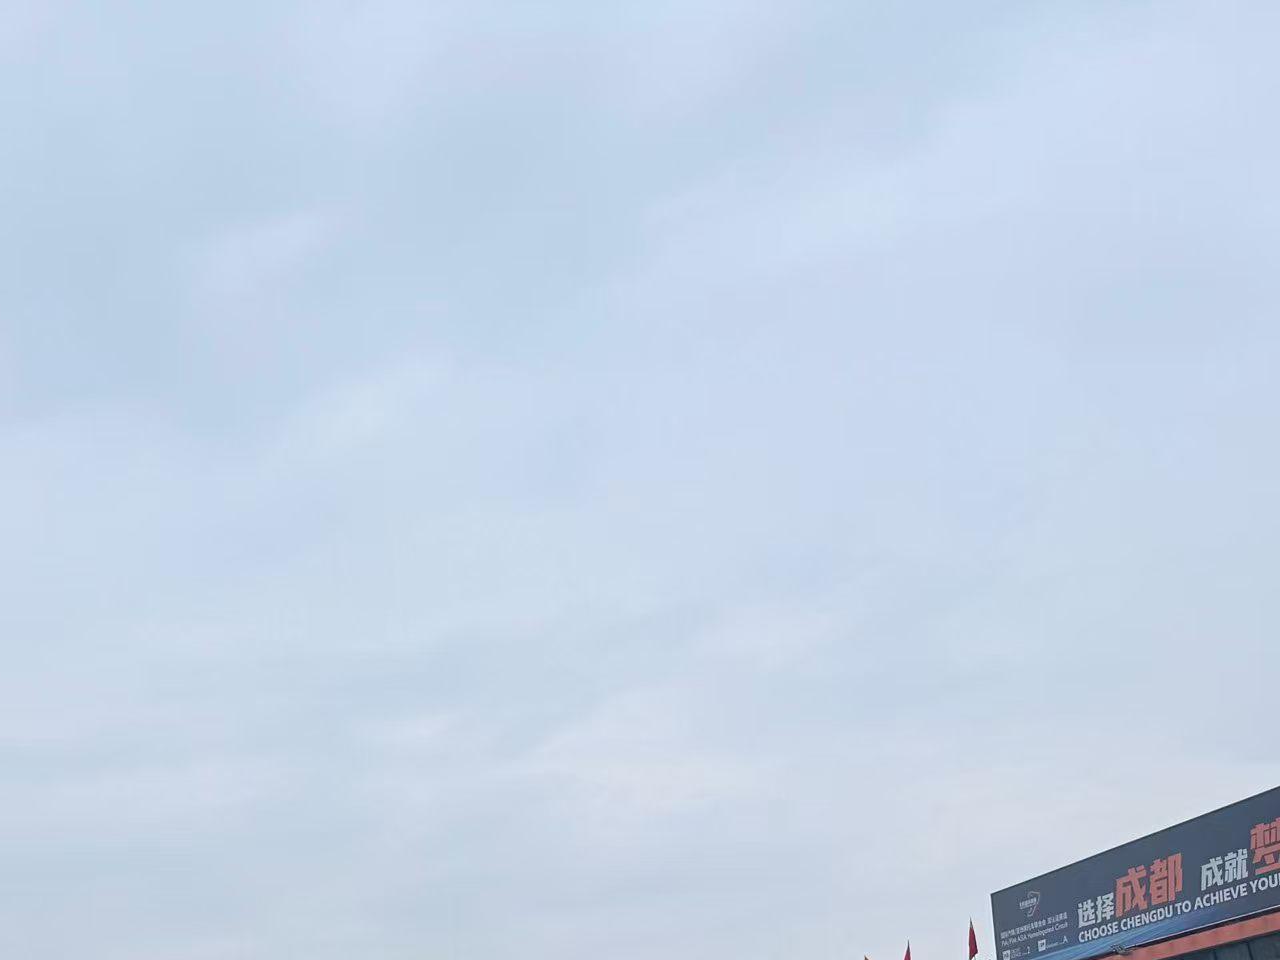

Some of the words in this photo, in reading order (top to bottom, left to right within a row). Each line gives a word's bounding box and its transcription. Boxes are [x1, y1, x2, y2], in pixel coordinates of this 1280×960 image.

[1078, 853, 1183, 928] 选择成都
[1078, 921, 1119, 944] CHOOSE
[1120, 904, 1173, 932] CHENGDU
[1175, 900, 1192, 915] TO
[1194, 882, 1248, 911] ACHIEVE
[1250, 872, 1280, 894] YOU
